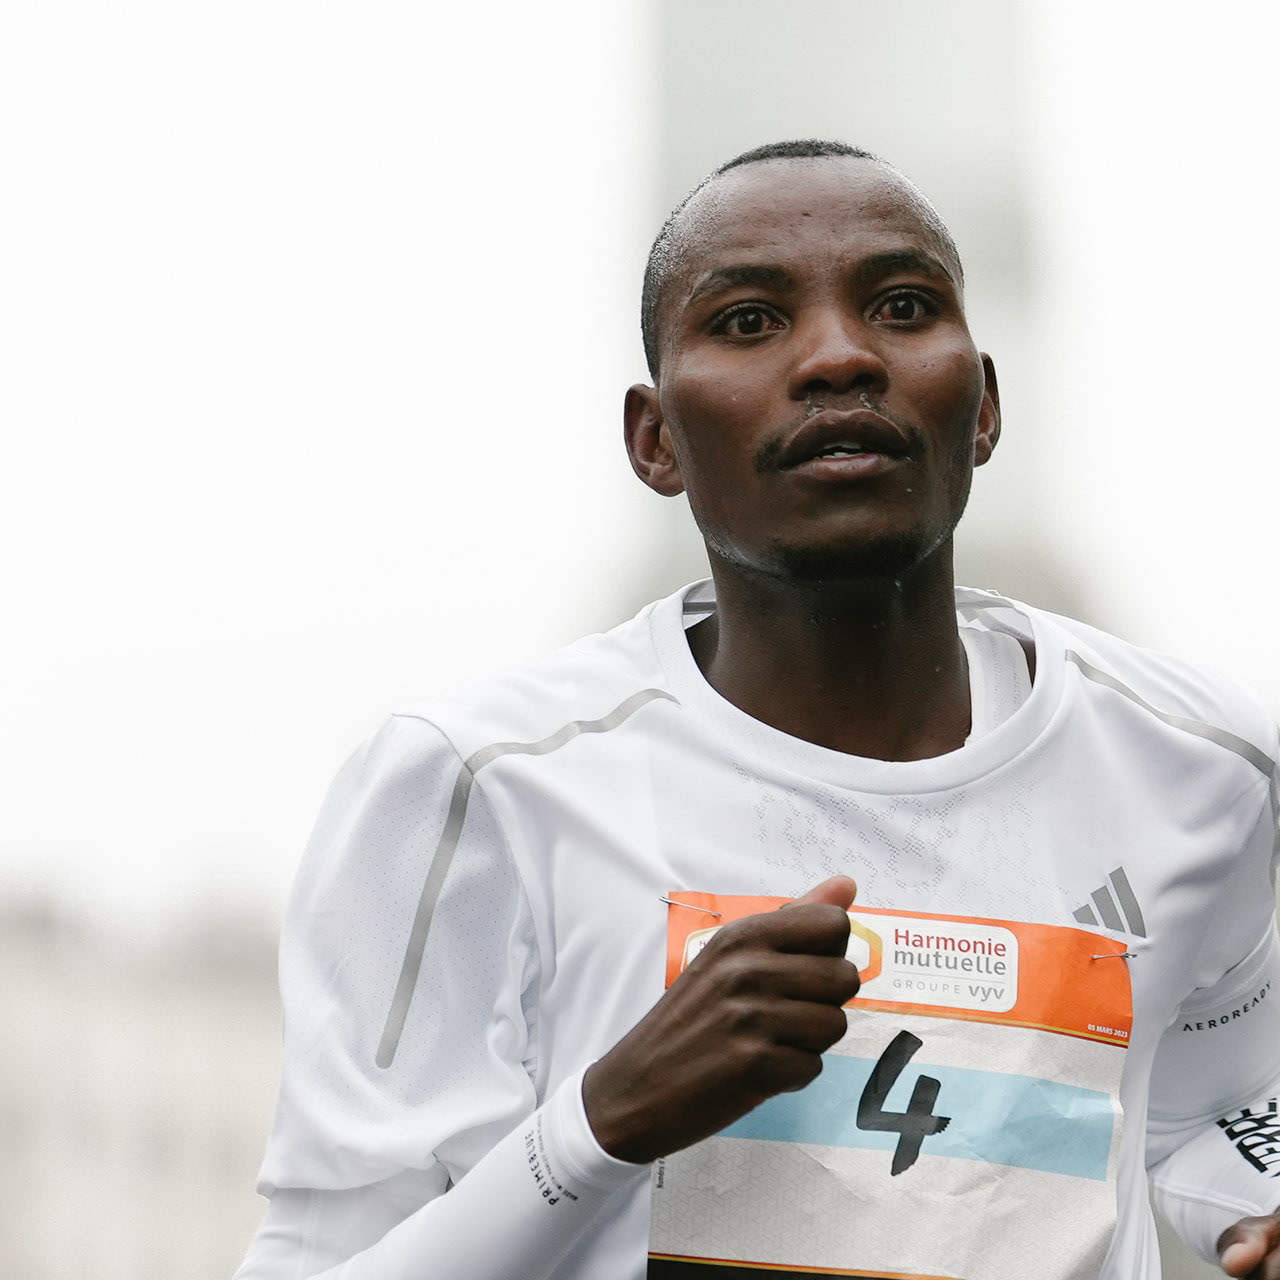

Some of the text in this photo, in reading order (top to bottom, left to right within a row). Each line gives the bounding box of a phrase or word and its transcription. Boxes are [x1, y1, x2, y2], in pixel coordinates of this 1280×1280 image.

[894, 928, 1007, 957] Harmonie
[894, 950, 1007, 976] mutuelle
[893, 979, 1006, 1002] GROUPE vyv
[855, 1029, 952, 1177] 4
[524, 1130, 560, 1206] PRIMEBLUE
